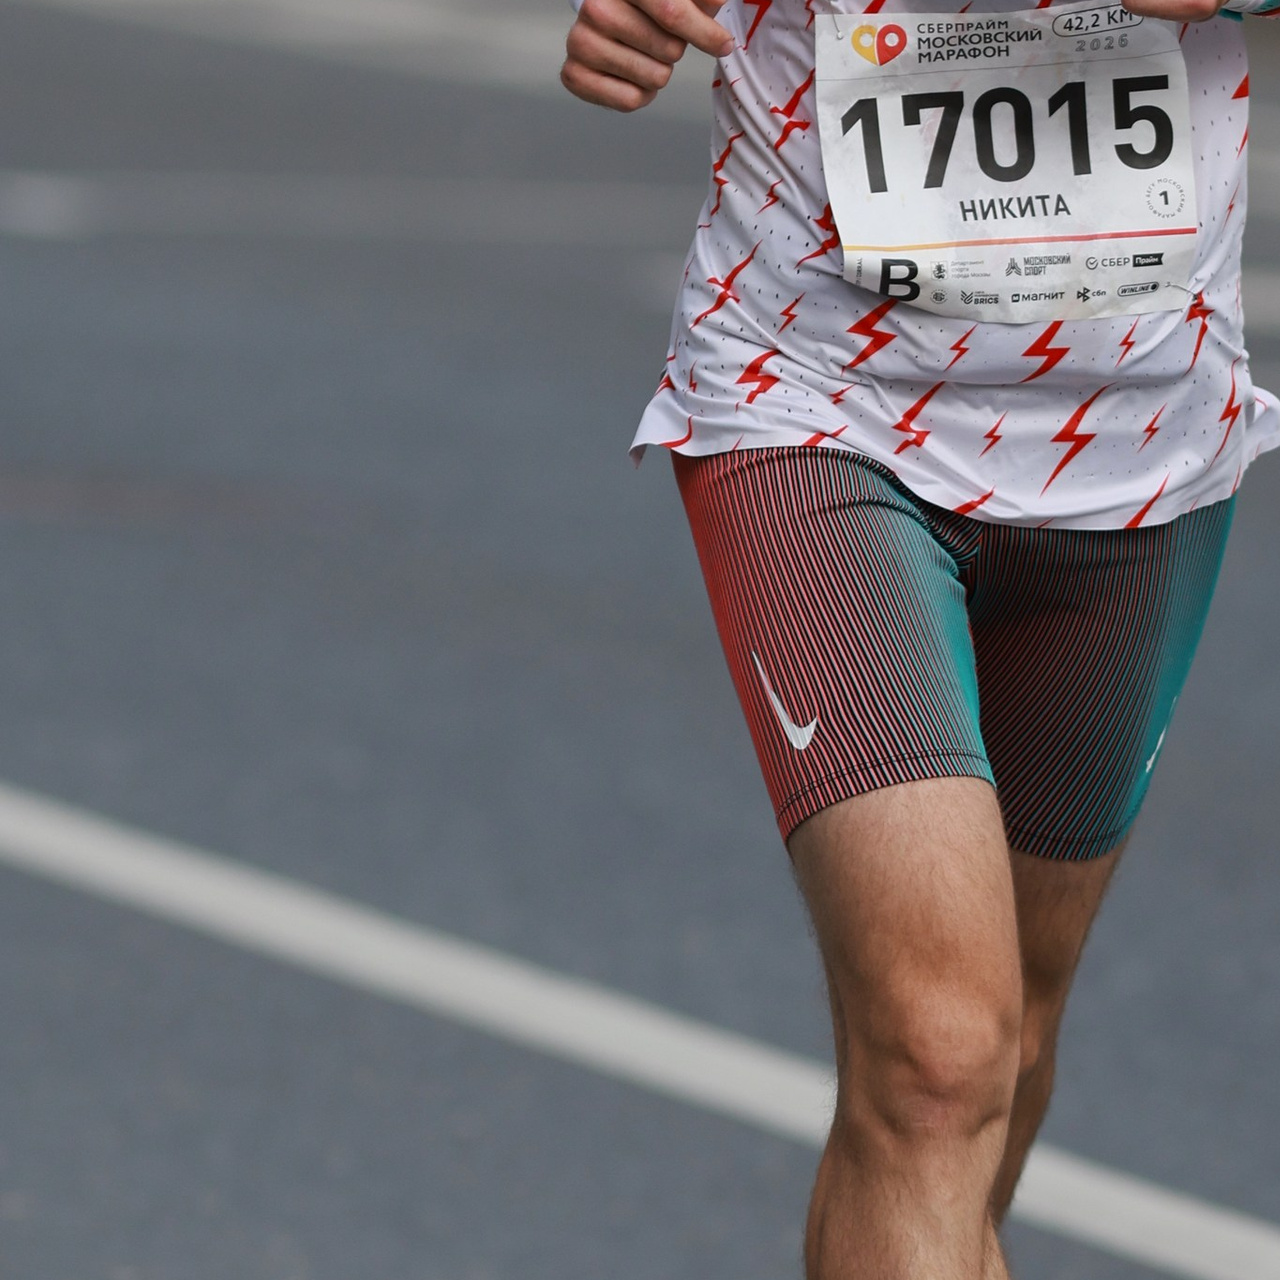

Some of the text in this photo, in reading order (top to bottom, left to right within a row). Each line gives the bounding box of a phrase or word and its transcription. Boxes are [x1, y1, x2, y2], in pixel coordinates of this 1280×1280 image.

[917, 20, 1009, 35] СБЕРПРАЙМ
[1063, 13, 1100, 32] 42,2
[918, 28, 1042, 50] МОСКОВСКИЙ
[1075, 33, 1129, 52] 2026
[918, 45, 1010, 63] МАРАФОН
[840, 74, 1174, 194] 17015
[1158, 190, 1169, 205] 1
[959, 192, 1071, 222] НИКИТА
[1023, 253, 1071, 265] МОСКОВСКИЙ
[1101, 256, 1159, 267] СБЕР Прайм
[1024, 266, 1047, 276] СПОРТ
[879, 258, 921, 302] B
[1021, 291, 1065, 302] магнит
[1120, 285, 1150, 295] WINLINE
[974, 297, 999, 305] BRICS
